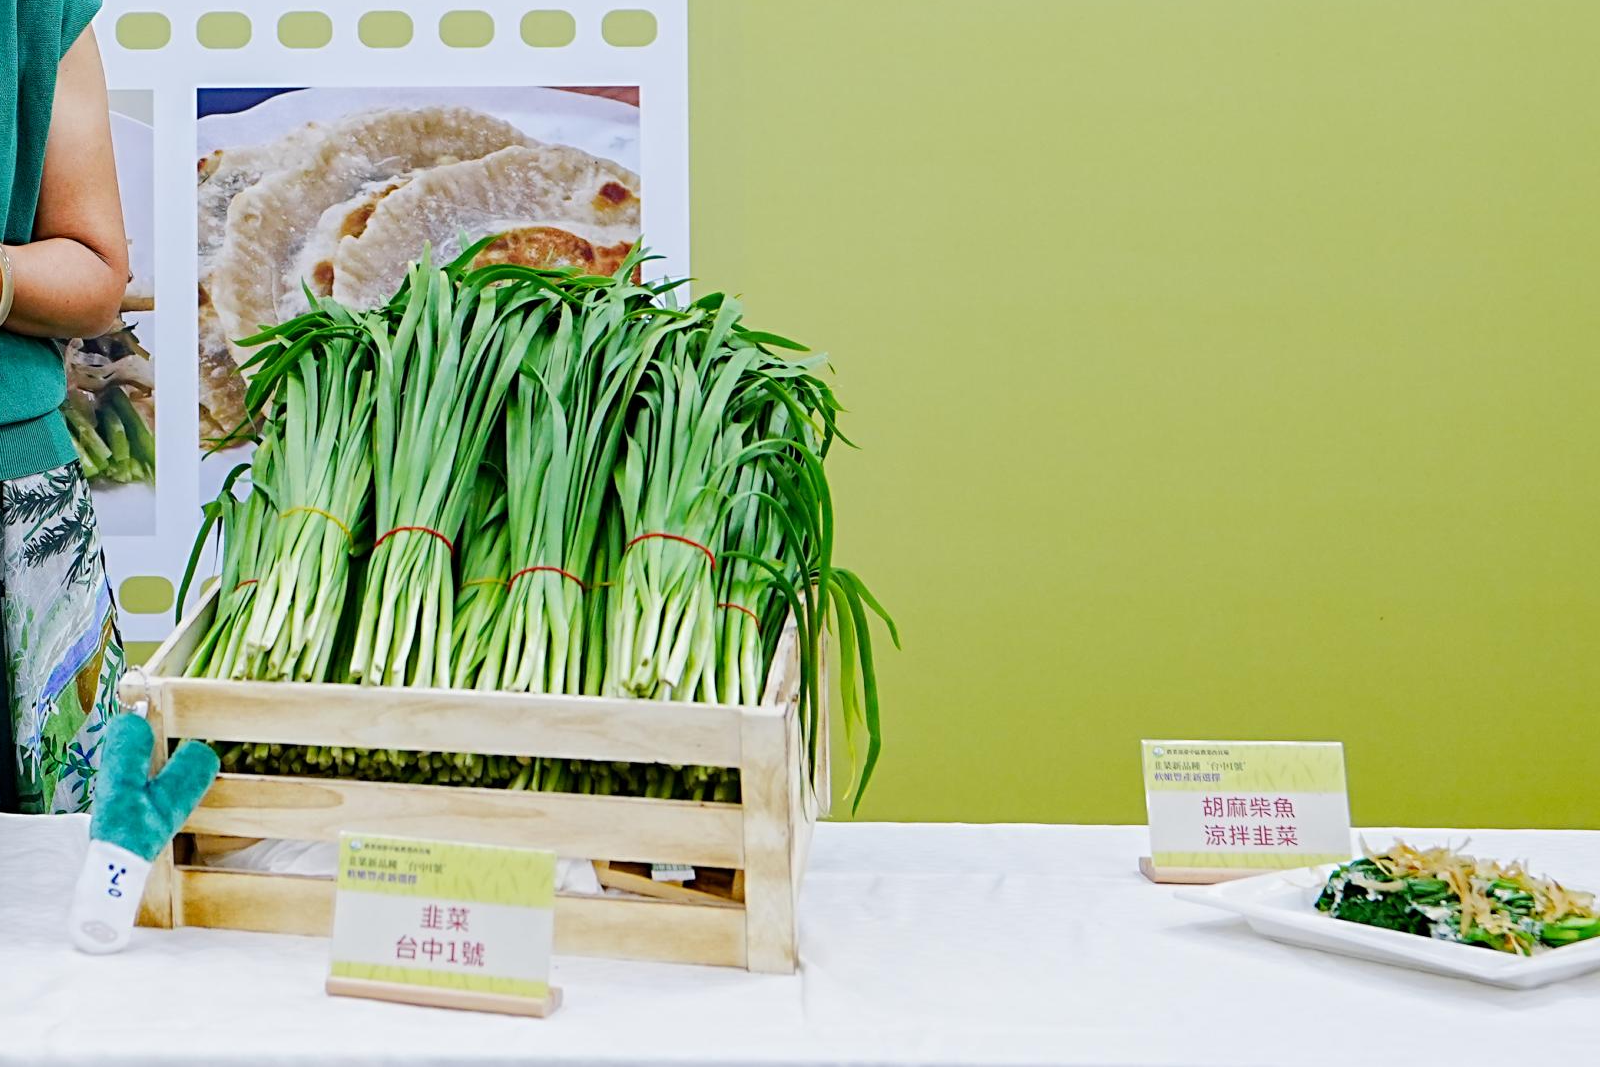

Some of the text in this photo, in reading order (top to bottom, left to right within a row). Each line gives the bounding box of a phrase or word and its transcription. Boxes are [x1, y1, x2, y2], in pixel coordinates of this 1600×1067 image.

[1201, 796, 1296, 819] 胡麻柴魚
[1204, 824, 1299, 847] 涼拌韭菜
[419, 904, 471, 932] 韭菜
[395, 935, 487, 968] 台中1號
